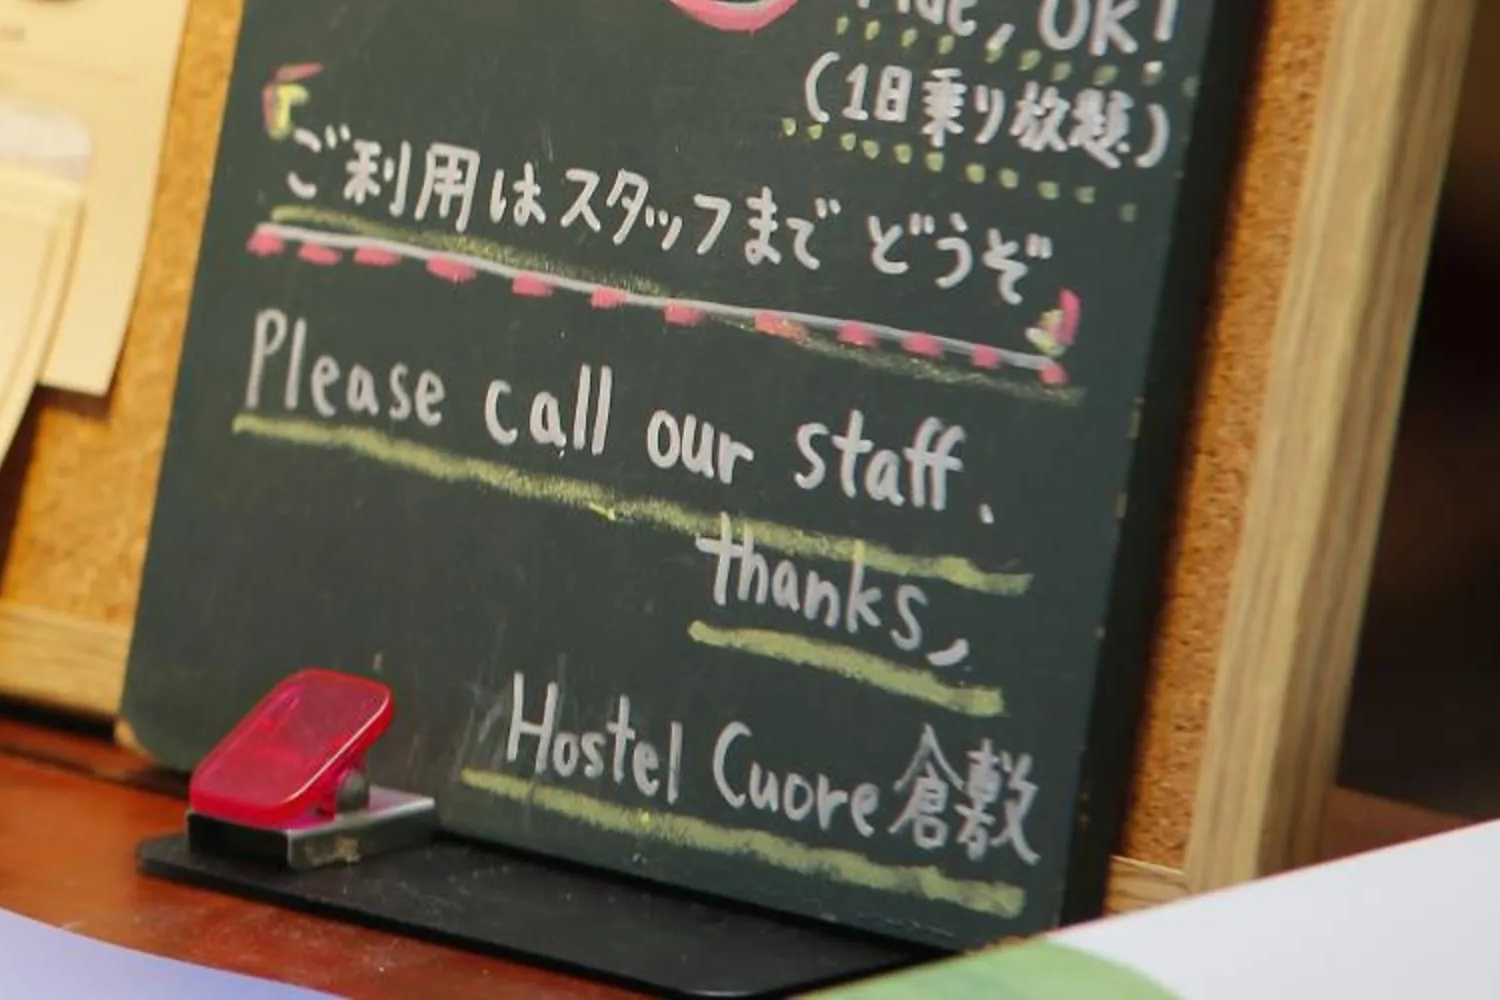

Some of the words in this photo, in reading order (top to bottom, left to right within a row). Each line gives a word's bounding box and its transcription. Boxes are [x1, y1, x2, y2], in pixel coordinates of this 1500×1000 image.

[243, 308, 446, 424] Please
[483, 364, 613, 456] call
[647, 412, 755, 488] our
[504, 671, 684, 804] Hostel
[711, 722, 875, 838] Cuore
